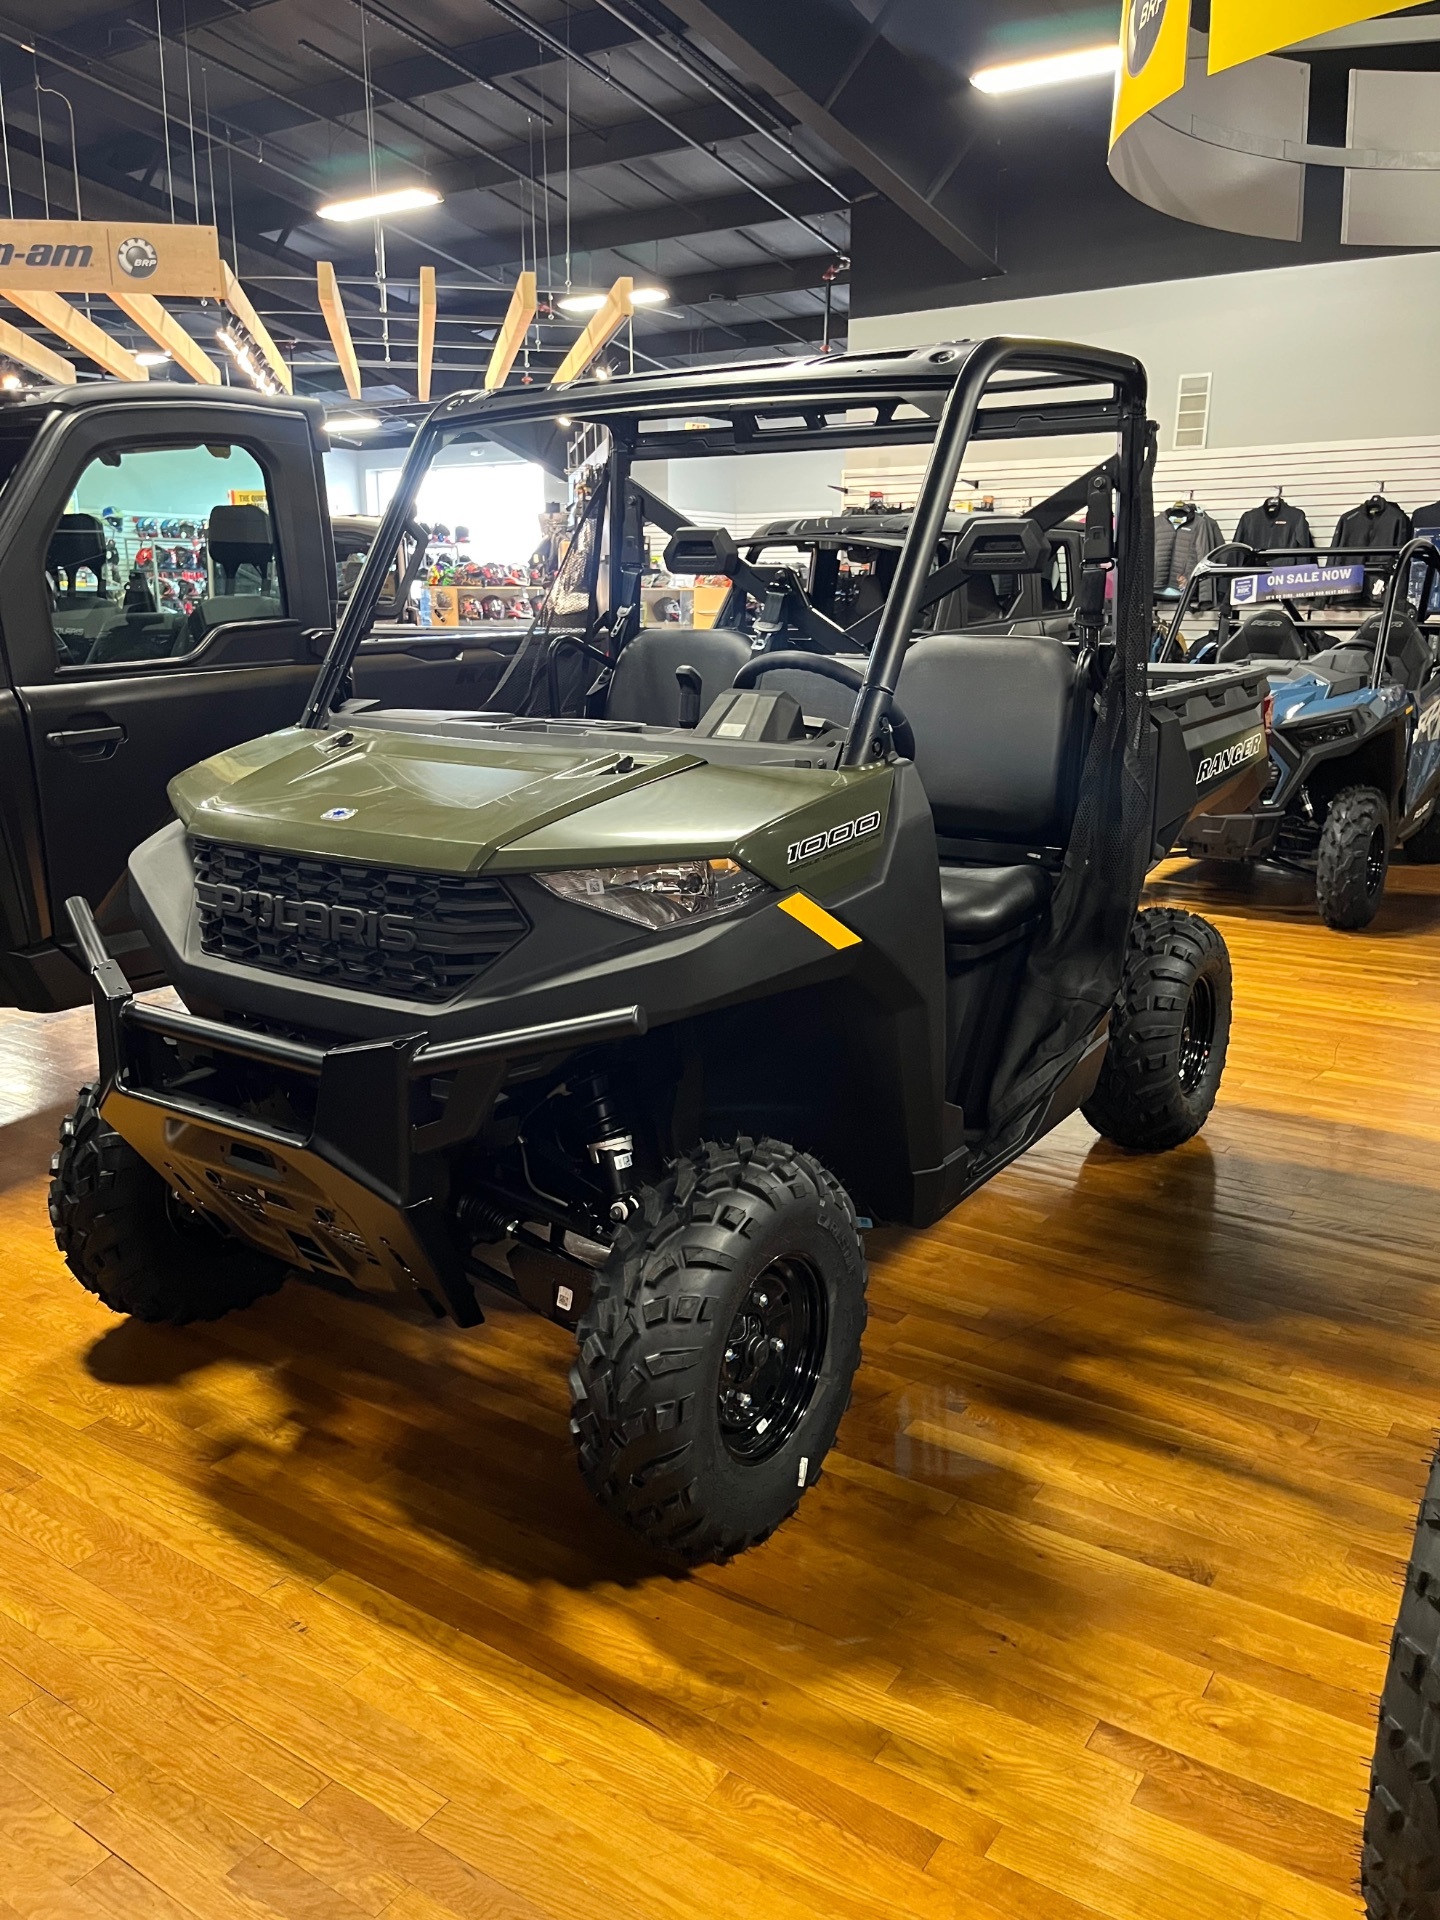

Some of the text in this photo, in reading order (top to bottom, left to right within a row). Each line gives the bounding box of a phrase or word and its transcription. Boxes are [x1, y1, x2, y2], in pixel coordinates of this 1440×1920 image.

[134, 258, 157, 267] BRP
[1267, 568, 1352, 586] ON SALE NOW
[1195, 732, 1262, 785] RANGER
[787, 810, 881, 865] 1000
[215, 883, 418, 953] POLARIS
